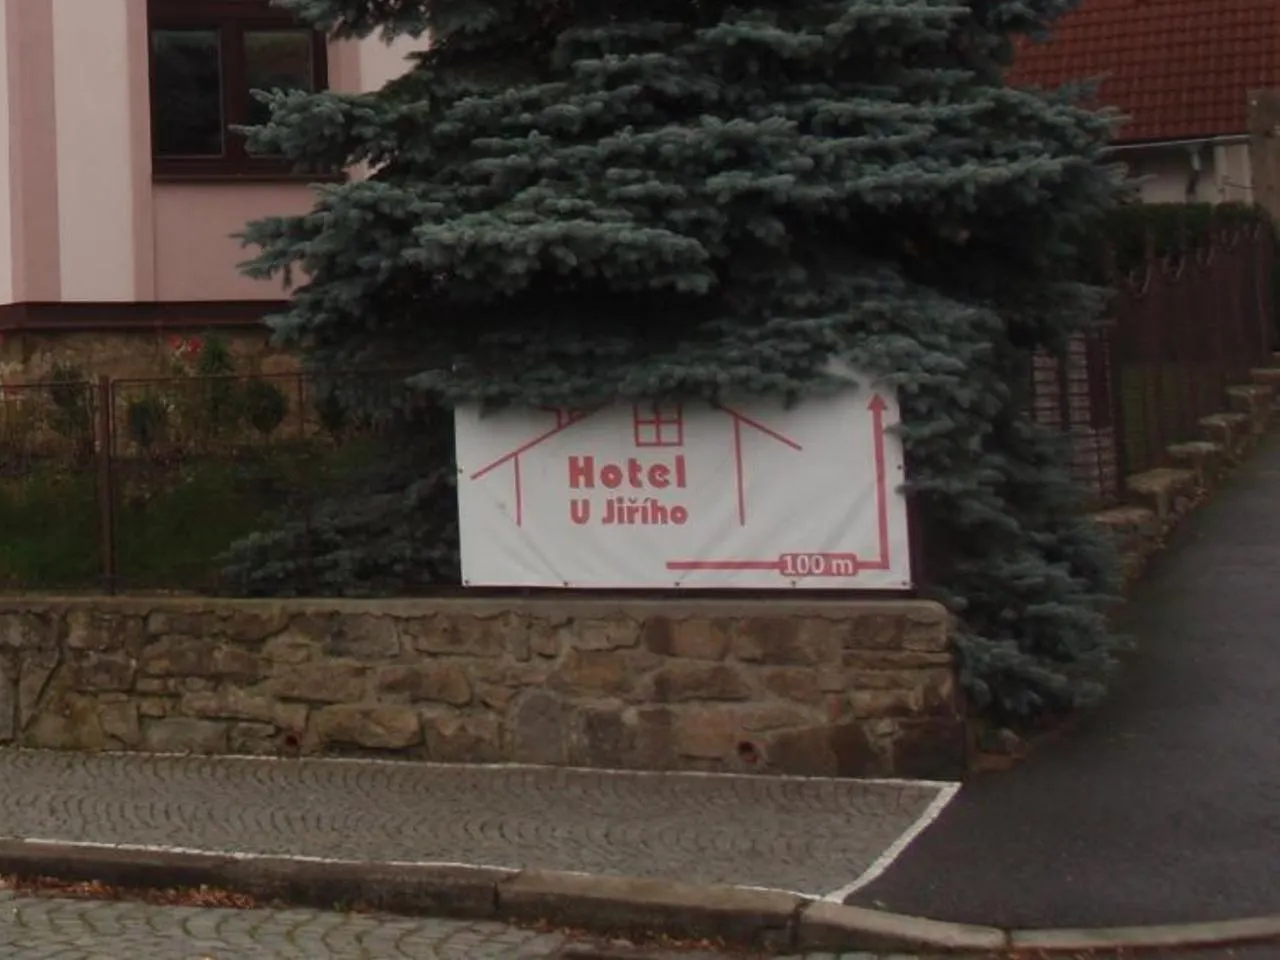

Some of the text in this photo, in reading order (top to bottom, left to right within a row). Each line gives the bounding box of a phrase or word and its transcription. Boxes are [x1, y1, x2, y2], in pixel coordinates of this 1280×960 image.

[568, 455, 687, 489] Hotel
[570, 496, 688, 525] U Jiřího
[782, 554, 854, 575] 100 m
